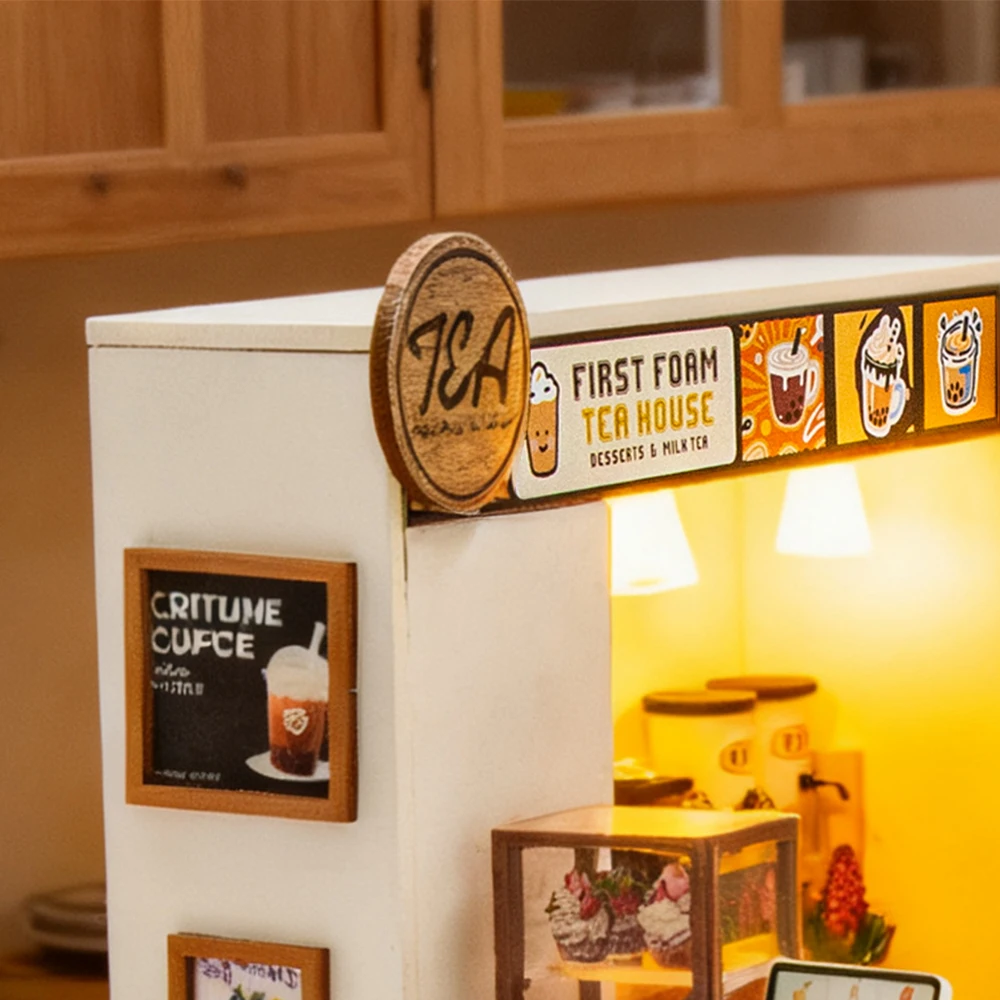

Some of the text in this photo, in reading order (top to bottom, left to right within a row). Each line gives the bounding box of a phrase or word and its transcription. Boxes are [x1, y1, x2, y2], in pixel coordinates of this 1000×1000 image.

[407, 305, 516, 416] TEA
[572, 346, 718, 401] FIRST FOAM
[581, 390, 715, 445] TEA HOUSE
[590, 435, 709, 468] DESSERTS & MILK TEA
